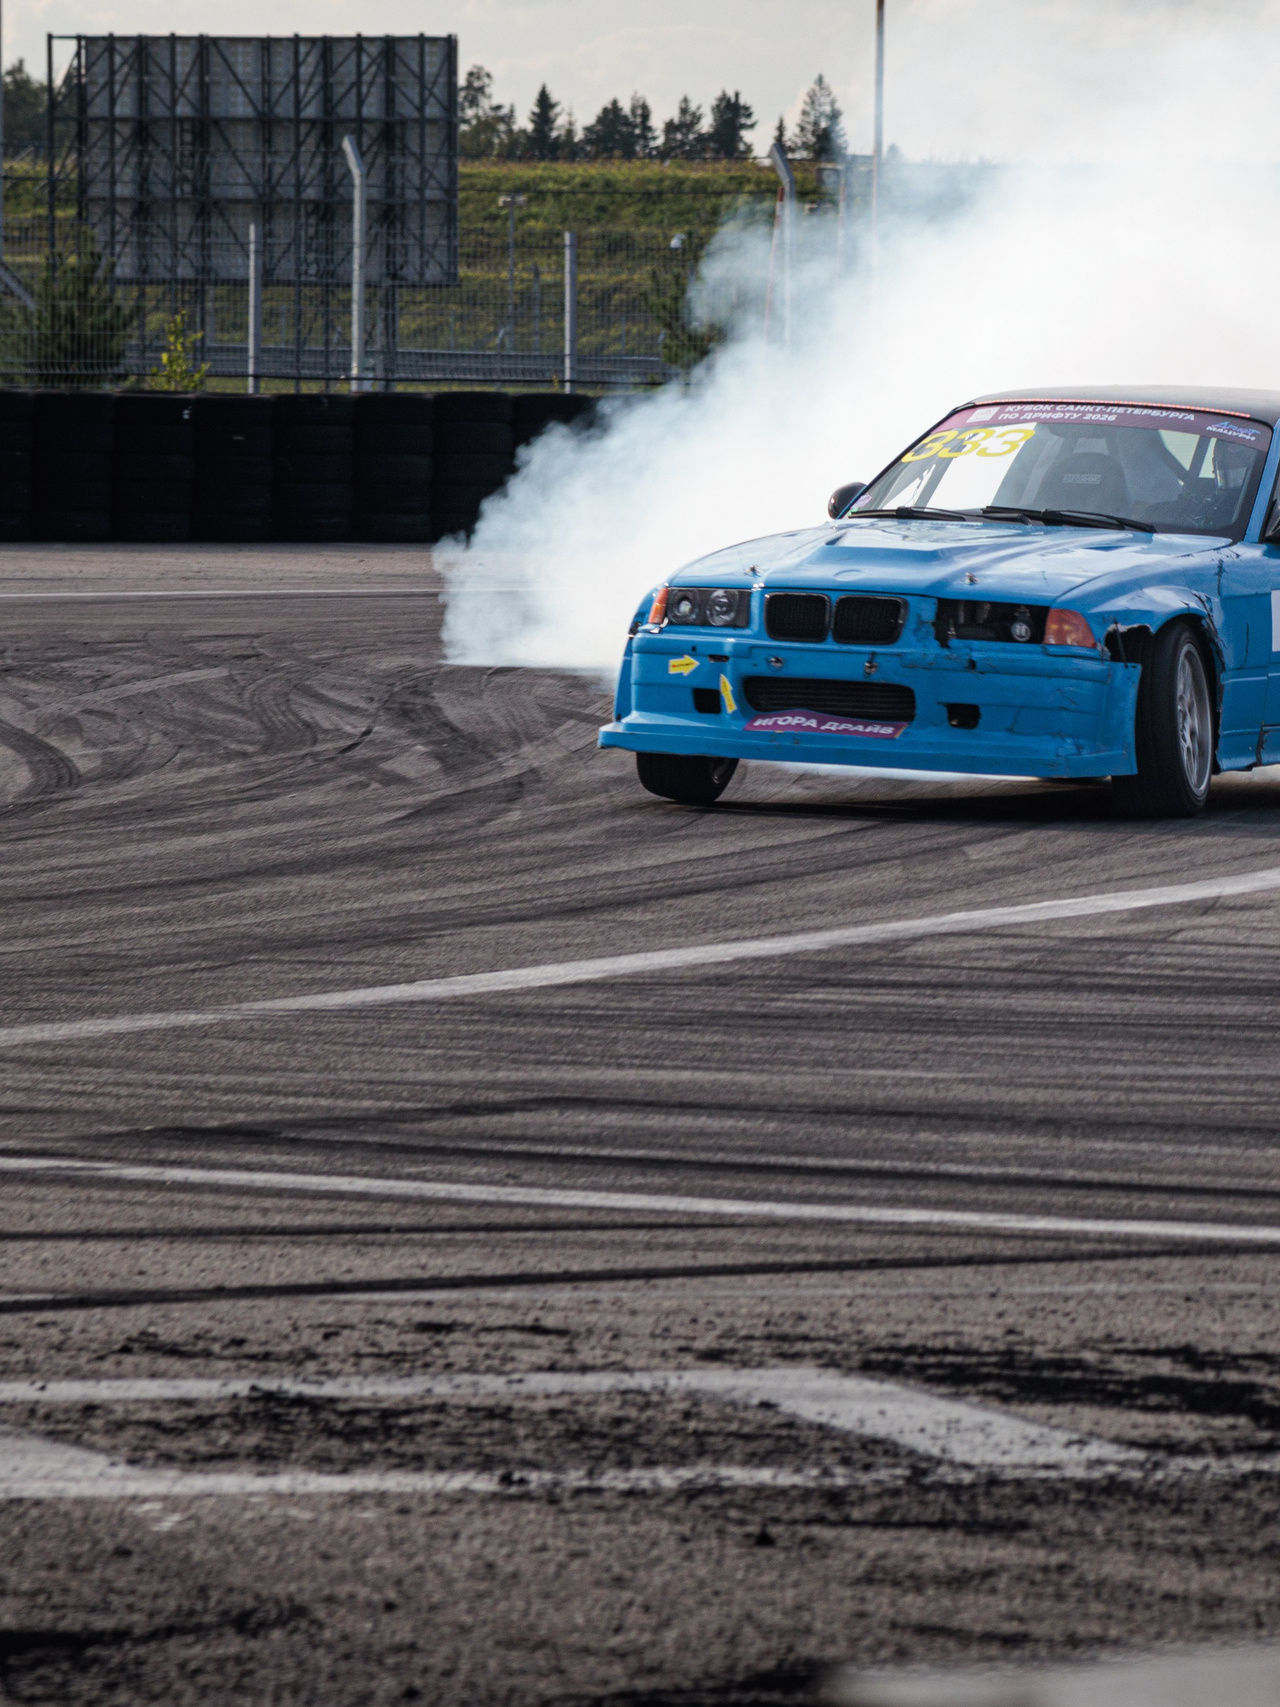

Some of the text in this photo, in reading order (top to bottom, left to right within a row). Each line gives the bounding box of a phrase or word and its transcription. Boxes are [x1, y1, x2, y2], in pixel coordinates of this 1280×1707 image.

[1004, 404, 1195, 421] КУБОК САНКТ-ПЕТЕРБУРГА
[1019, 412, 1082, 420] ДРИФТУ
[1083, 413, 1118, 421] 2026
[901, 428, 1036, 463] 333
[753, 715, 895, 735] ИГОРА ДРАЙВ
